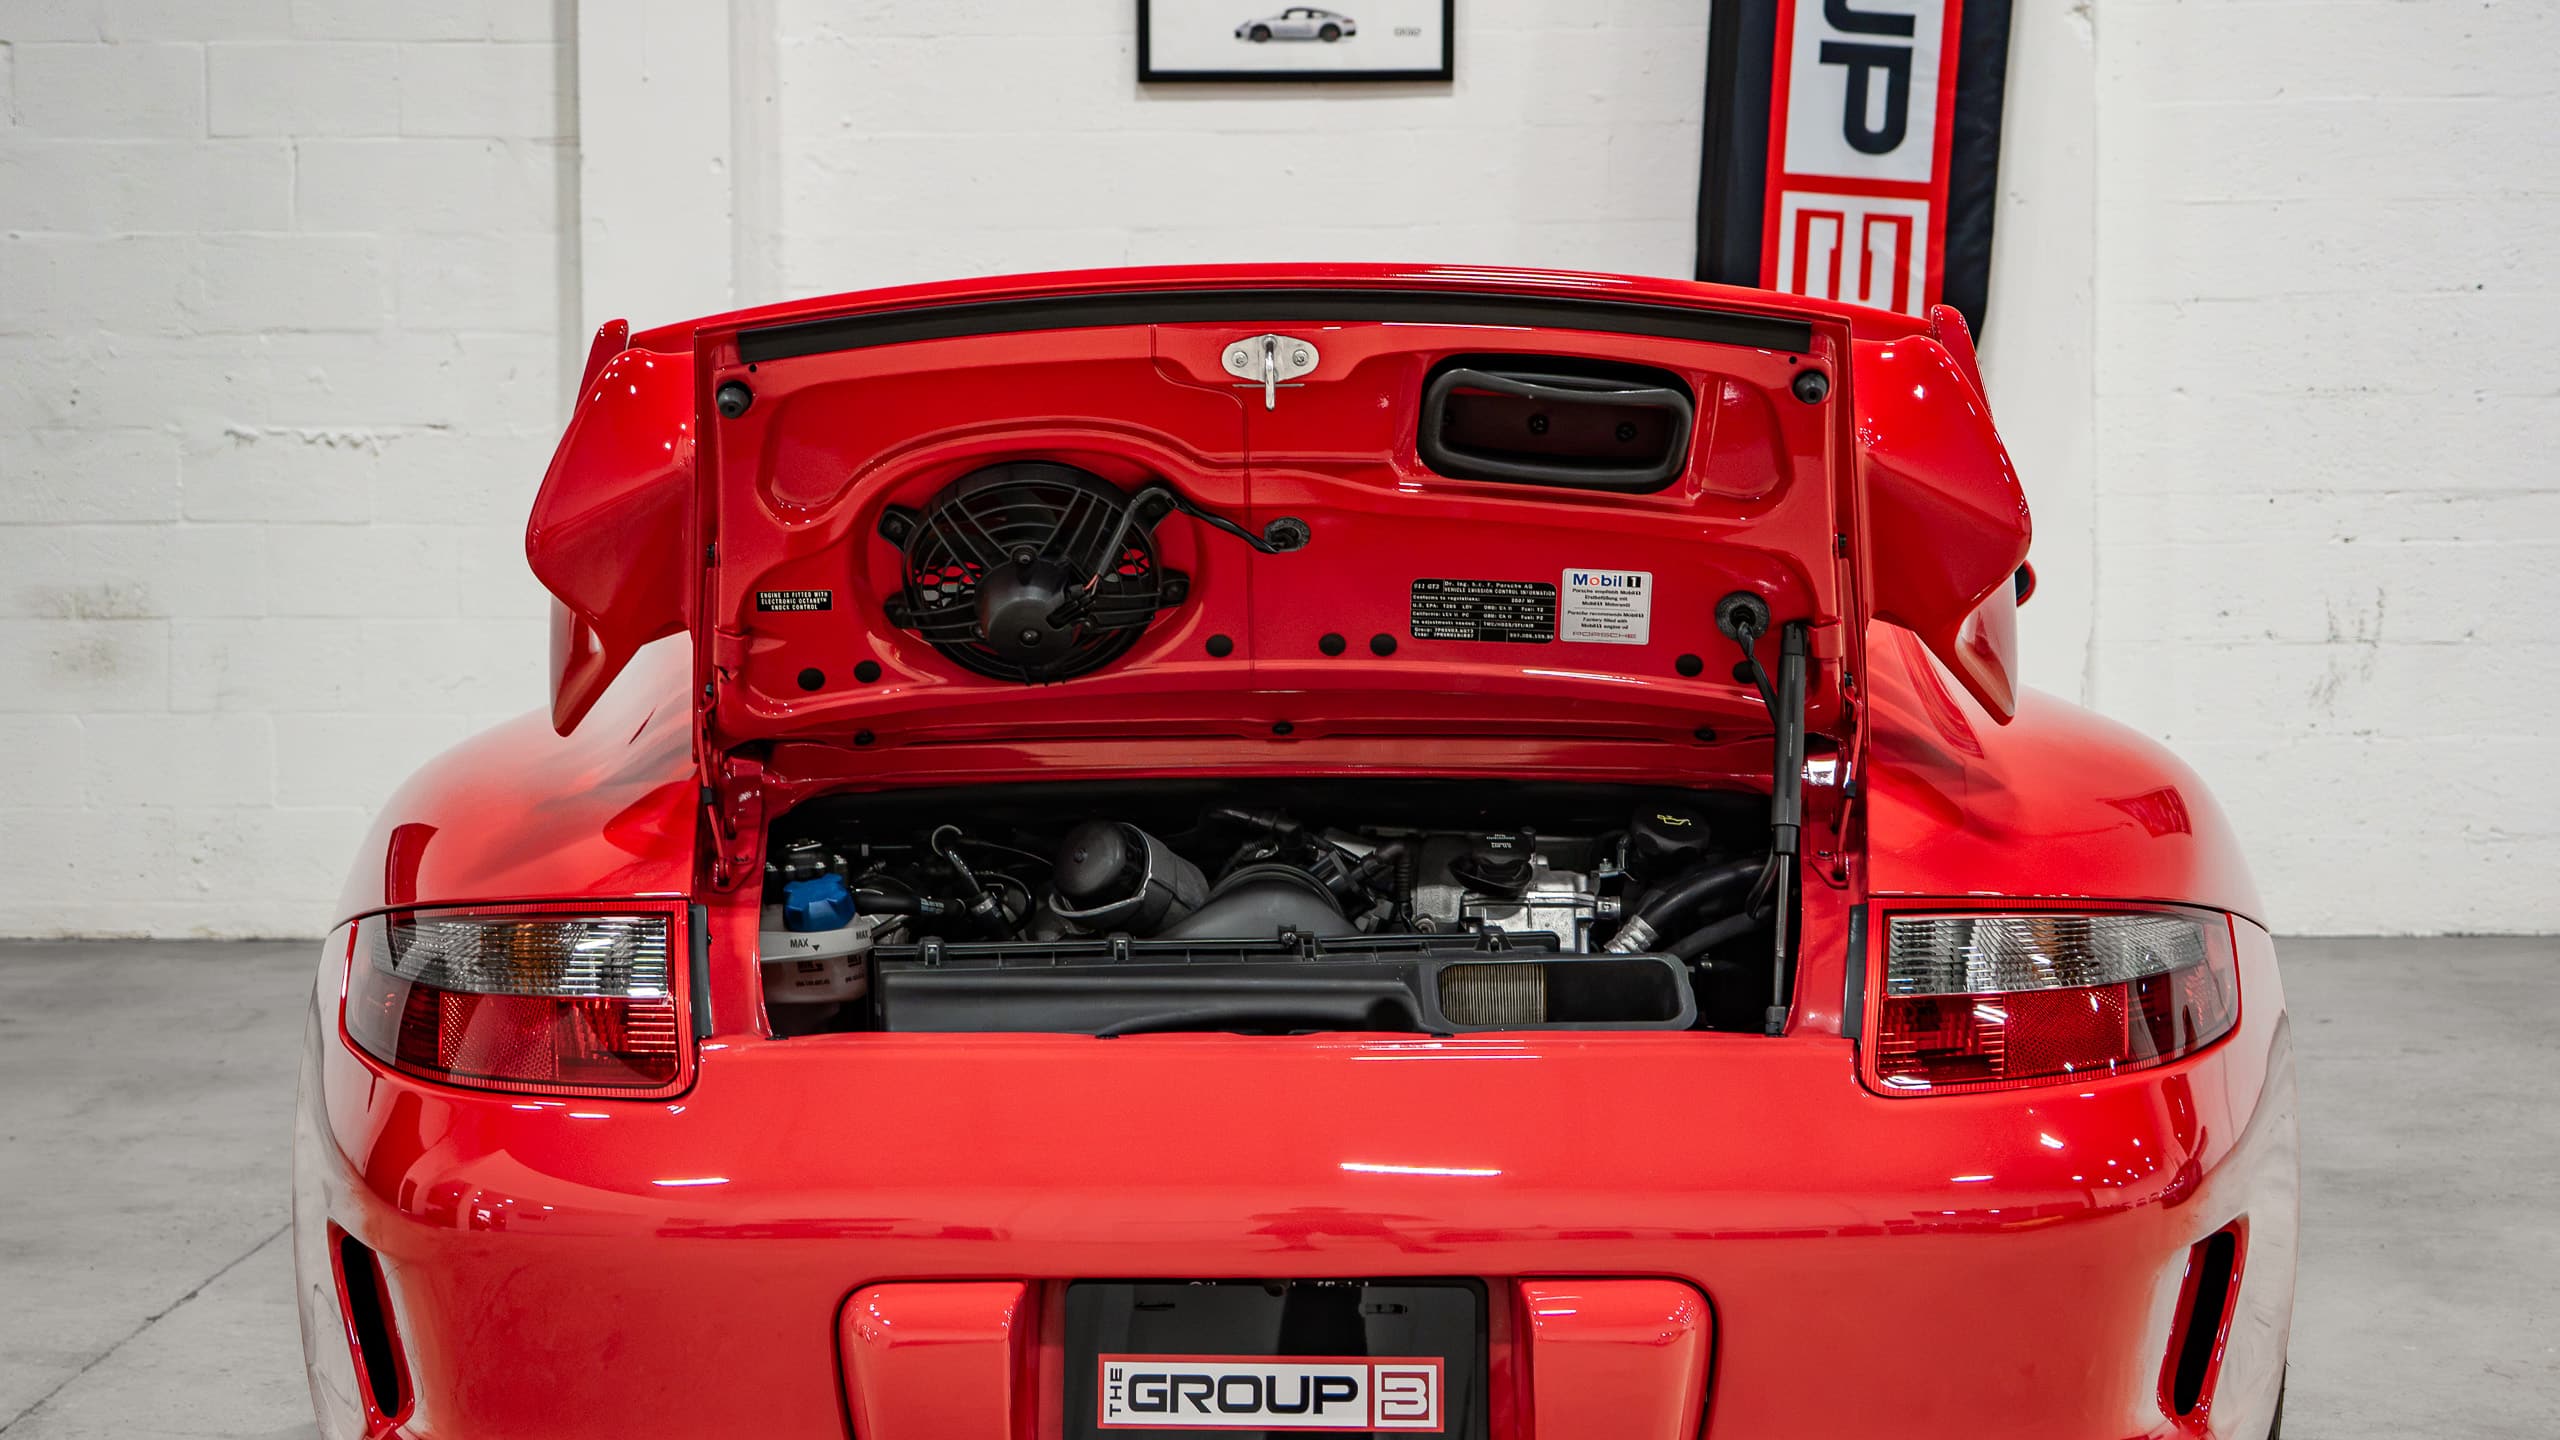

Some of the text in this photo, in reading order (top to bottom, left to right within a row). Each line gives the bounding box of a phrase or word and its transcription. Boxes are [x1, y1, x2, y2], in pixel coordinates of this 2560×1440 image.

[1573, 574, 1640, 587] Mobil 1
[856, 930, 868, 940] MAX
[790, 938, 808, 948] MAX
[1110, 1368, 1122, 1418] THE
[1128, 1374, 1358, 1414] GROUP
